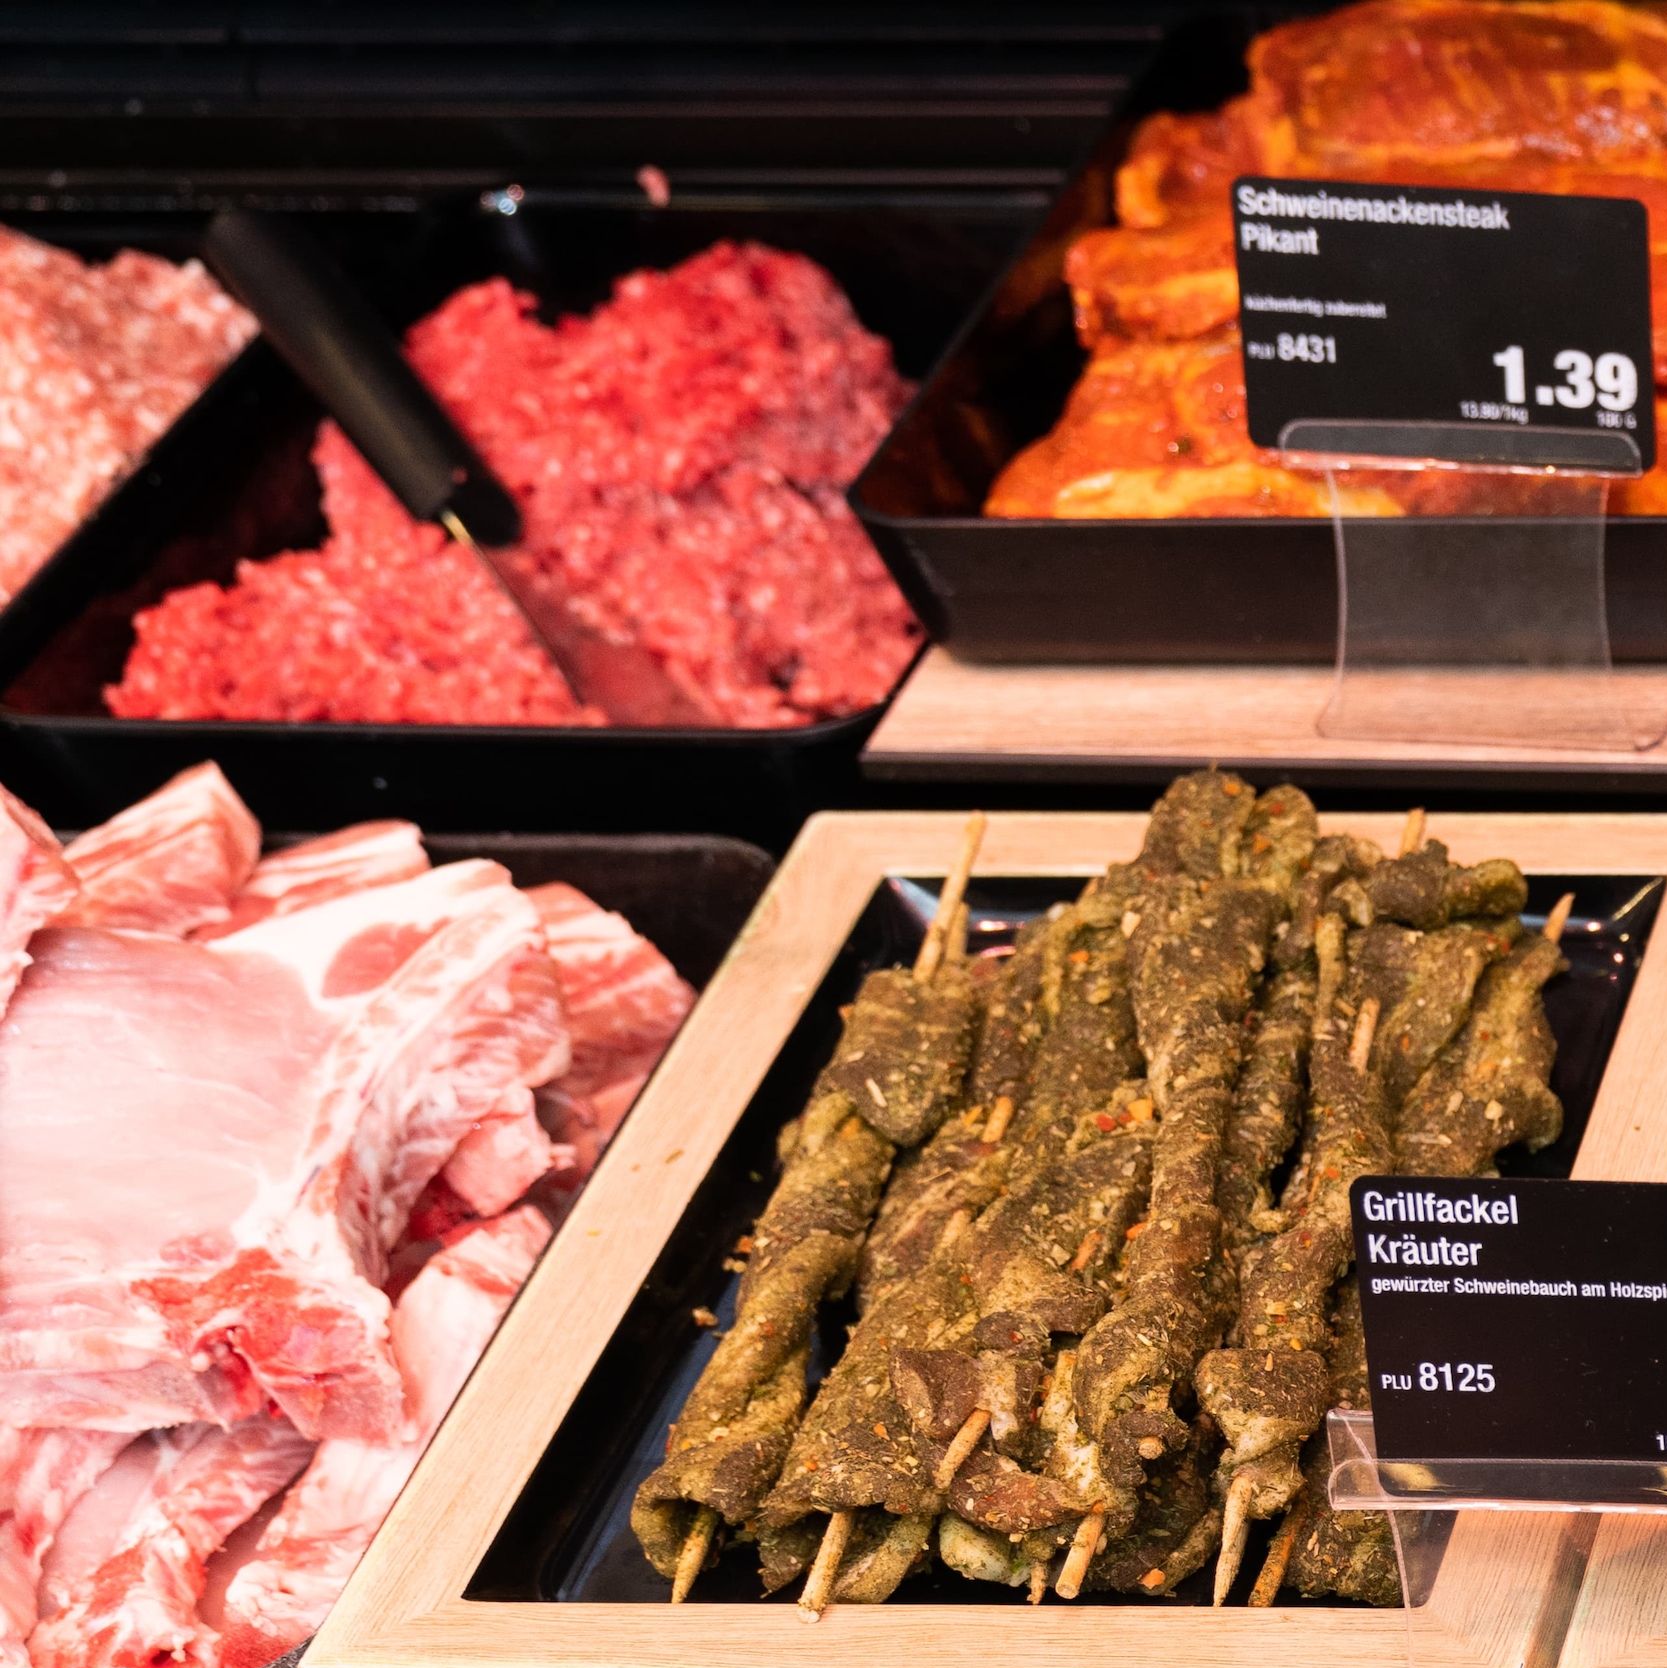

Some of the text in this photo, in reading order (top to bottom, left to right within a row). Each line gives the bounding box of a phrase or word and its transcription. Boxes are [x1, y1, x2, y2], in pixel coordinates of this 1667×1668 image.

[1238, 185, 1510, 230] Schweinenackensteak
[1240, 222, 1319, 255] Pikant
[1277, 333, 1336, 363] 8431
[1493, 345, 1638, 411] 1.39
[1364, 1191, 1518, 1224] Grillfackel
[1368, 1234, 1482, 1266] Kräuter
[1372, 1278, 1450, 1294] gewürzter
[1454, 1278, 1577, 1296] Schweinebauch
[1581, 1284, 1605, 1297] am
[1382, 1363, 1495, 1392] PLU 8125
